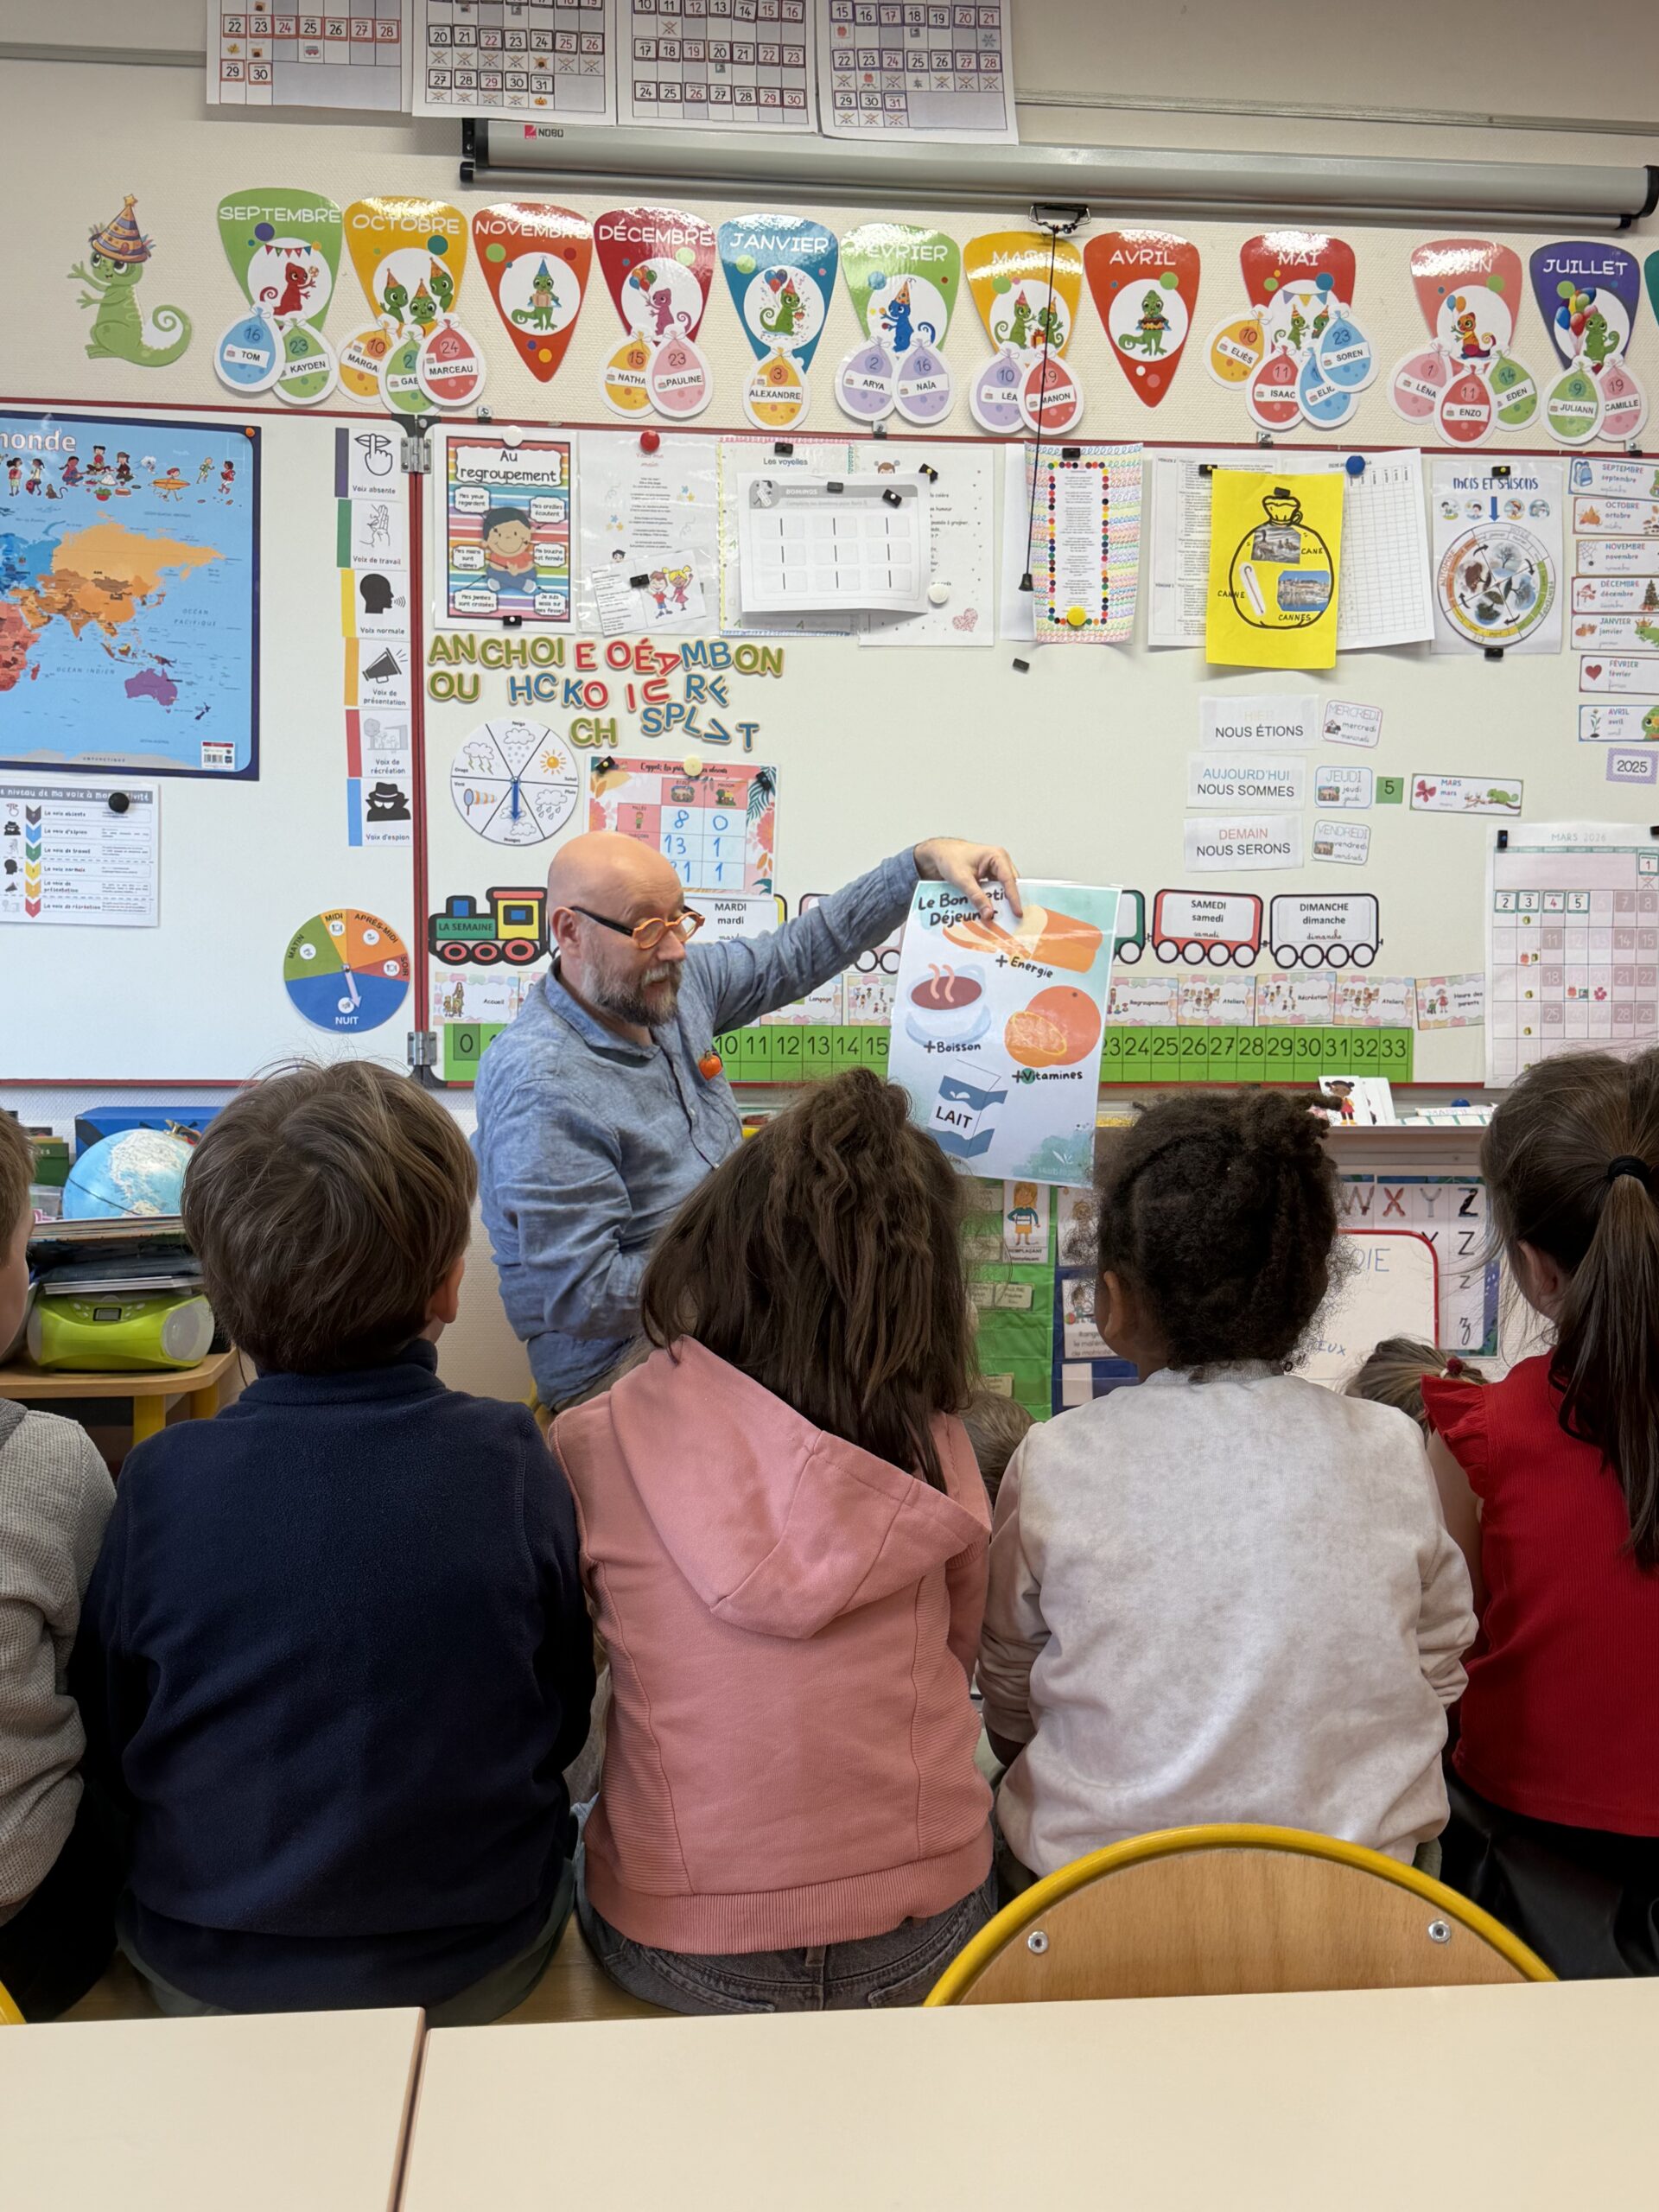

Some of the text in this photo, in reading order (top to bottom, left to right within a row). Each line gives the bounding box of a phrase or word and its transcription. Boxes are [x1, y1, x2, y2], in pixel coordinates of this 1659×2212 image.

[228, 22, 394, 38] 22 28
[639, 44, 728, 59] 17 20
[837, 54, 852, 67] 22
[433, 73, 548, 92] 27 28 31
[219, 206, 341, 223] SEPTEMBRE
[353, 214, 461, 234] OCTOBRE
[599, 219, 713, 245] DÉCEMBRE
[730, 233, 829, 253] JANVIER
[1109, 250, 1176, 265] AVRIL
[1279, 251, 1318, 265] MAI
[1543, 259, 1628, 275] JUILLET
[245, 327, 260, 340] 16
[1243, 329, 1257, 342] 10
[1332, 330, 1351, 345] 23
[289, 338, 308, 353] 23
[369, 339, 385, 353] 10
[441, 341, 459, 354] 24
[242, 351, 261, 362] TOM
[629, 352, 644, 365] 15
[669, 353, 686, 365] 23
[1337, 350, 1363, 361] SOREN
[290, 360, 326, 373] KAYDEN
[347, 354, 379, 372] MARGA
[869, 357, 879, 370] 2
[916, 359, 931, 372] 16
[429, 365, 474, 375] MARCEAU
[774, 368, 782, 380] 3
[999, 370, 1014, 382] 10
[1274, 366, 1288, 378] 11
[666, 375, 702, 385] PAULINE
[863, 379, 885, 391] ARYA
[917, 381, 936, 391] NAÏA
[1609, 380, 1624, 392] 19
[749, 390, 801, 400] ALEXANDRE
[1271, 390, 1295, 398] ISAAC
[1416, 385, 1436, 397] LÉNA
[1462, 388, 1476, 399] 11
[1506, 388, 1527, 401] EDEN
[1574, 384, 1581, 394] 9
[1002, 391, 1018, 401] LÉA
[1041, 392, 1070, 404] MANON
[1560, 404, 1593, 414] JULIANN
[1605, 399, 1638, 411] CAMILLE
[1459, 409, 1481, 417] ENZO
[500, 451, 517, 462] Au
[1602, 464, 1643, 474] SEPTEMBRE
[461, 468, 556, 484] regroupement
[1602, 475, 1636, 484] septembre
[1453, 478, 1478, 490] MOIS
[1483, 479, 1495, 490] ET
[1217, 590, 1245, 599] CANNE
[1610, 659, 1638, 668] FÉVRIER
[364, 697, 406, 706] présentation
[1329, 704, 1380, 721] MERCREDI
[1216, 724, 1304, 738] NOUS ÉTIONS
[1618, 760, 1647, 773] 2025
[1203, 768, 1290, 780] AUJOURD'HUI
[1325, 771, 1362, 783] JEUDI
[1198, 785, 1294, 797] NOUS SOMMES
[1384, 780, 1395, 794] 5
[674, 810, 690, 830] 8
[383, 834, 410, 842] d'espion
[1219, 829, 1268, 840] DEMAIN
[1318, 825, 1368, 839] VENDREDI
[1551, 833, 1605, 842] MARS 2026
[664, 835, 721, 857] 13 1
[1197, 843, 1291, 856] NOUS SERONS
[918, 893, 968, 911] Le Bon
[1191, 899, 1227, 910] SAMEDI
[1300, 902, 1349, 912] DIMANCHE
[1502, 897, 1581, 908] 2 3 4 5
[325, 912, 343, 922] MIDI
[930, 910, 998, 926] Déjeunr
[1192, 913, 1224, 923] samedi
[1303, 915, 1346, 925] dimanche
[439, 922, 493, 931] LA SEMAINE
[288, 934, 305, 959] MATIN
[400, 956, 409, 976] SOIR
[1011, 957, 1053, 978] Energie
[1129, 999, 1169, 1007] Regroupement
[335, 1016, 359, 1025] NUIT
[460, 1033, 473, 1052] 0
[715, 1036, 888, 1056] 10 11 13 15
[1125, 1037, 1407, 1058] 24 26 28 30 32 33
[936, 1106, 972, 1128] LAIT
[1383, 1187, 1478, 1217] X Y Z
[1459, 1231, 1475, 1255] Z
